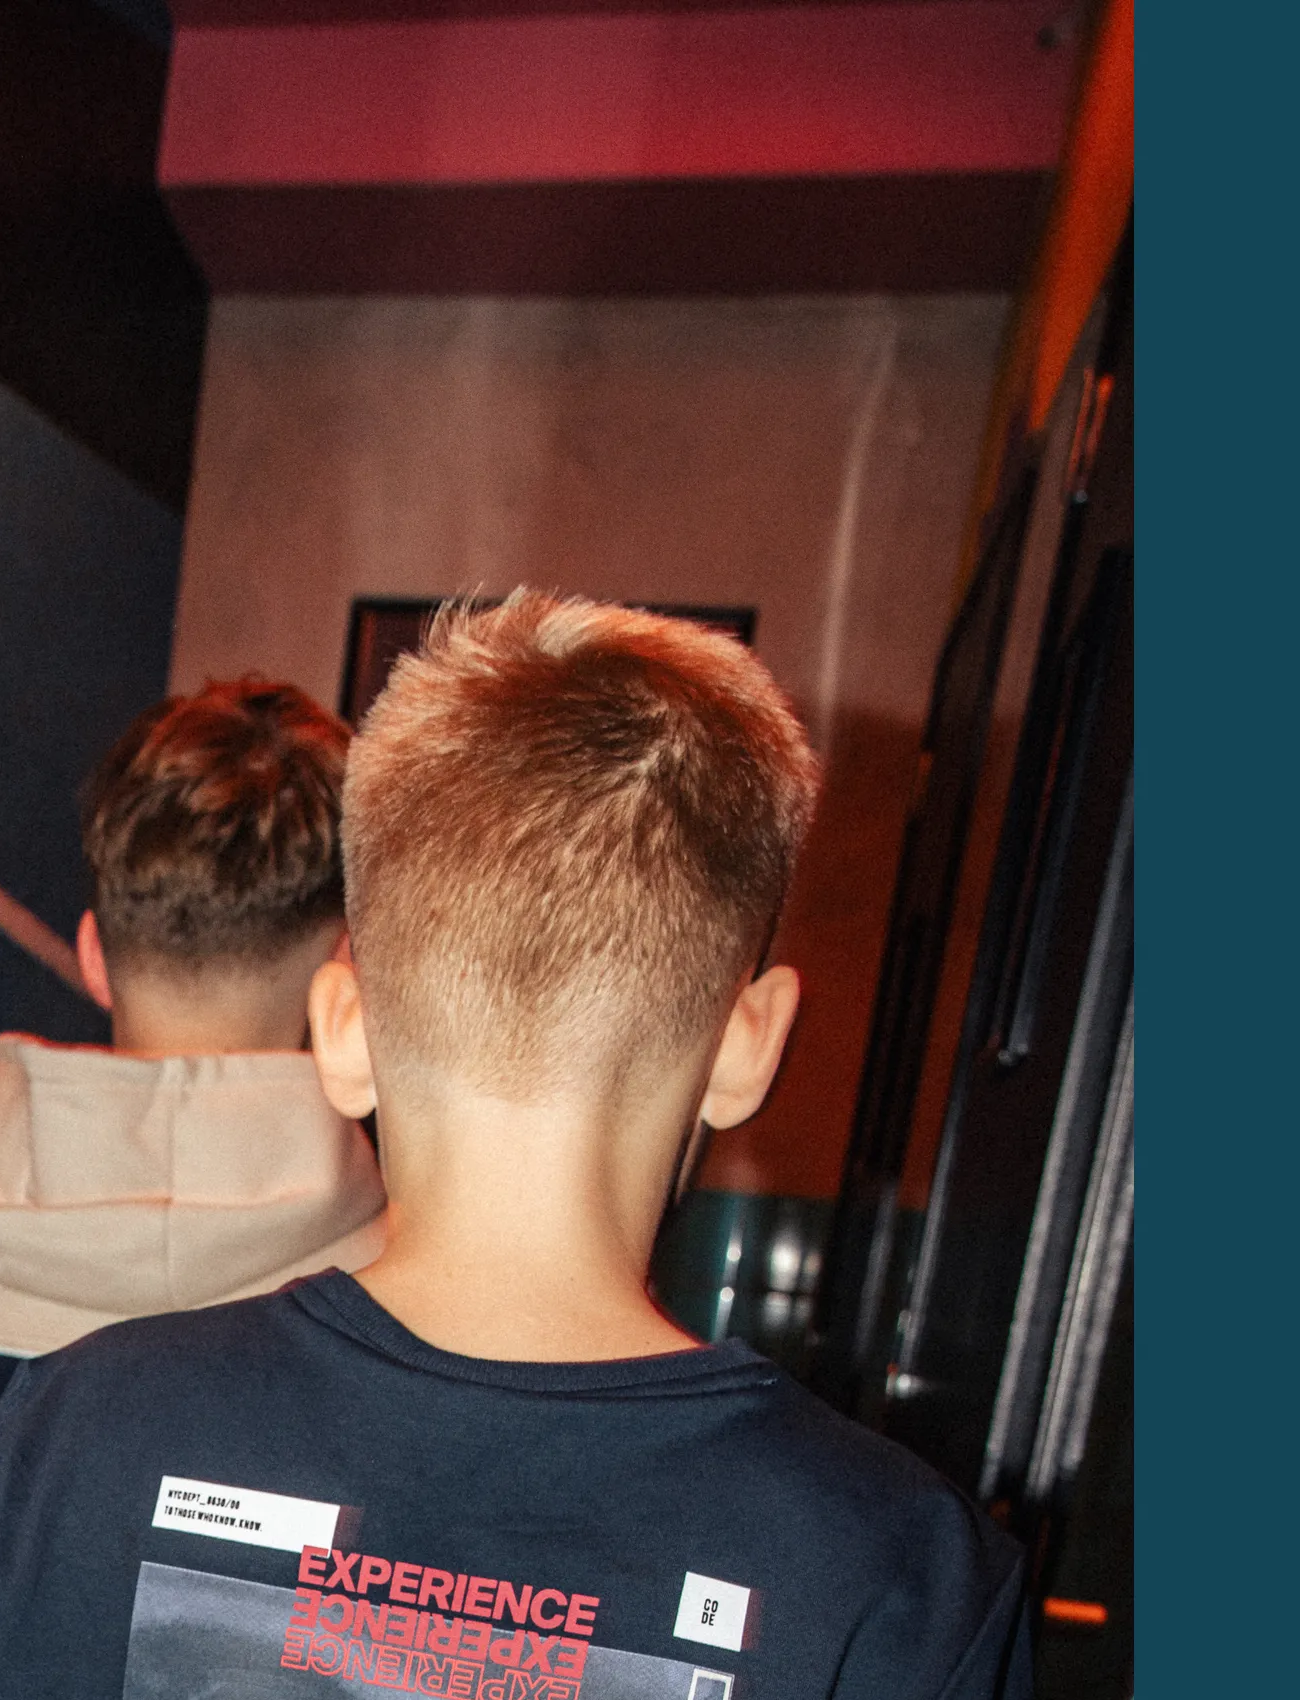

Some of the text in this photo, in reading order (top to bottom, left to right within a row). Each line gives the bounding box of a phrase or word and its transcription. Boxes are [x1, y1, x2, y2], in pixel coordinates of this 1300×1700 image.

[298, 1545, 600, 1636] EXPERIENCE
[703, 1598, 719, 1613] CO
[289, 1587, 590, 1680] EXPERIENCE
[701, 1612, 716, 1626] DE
